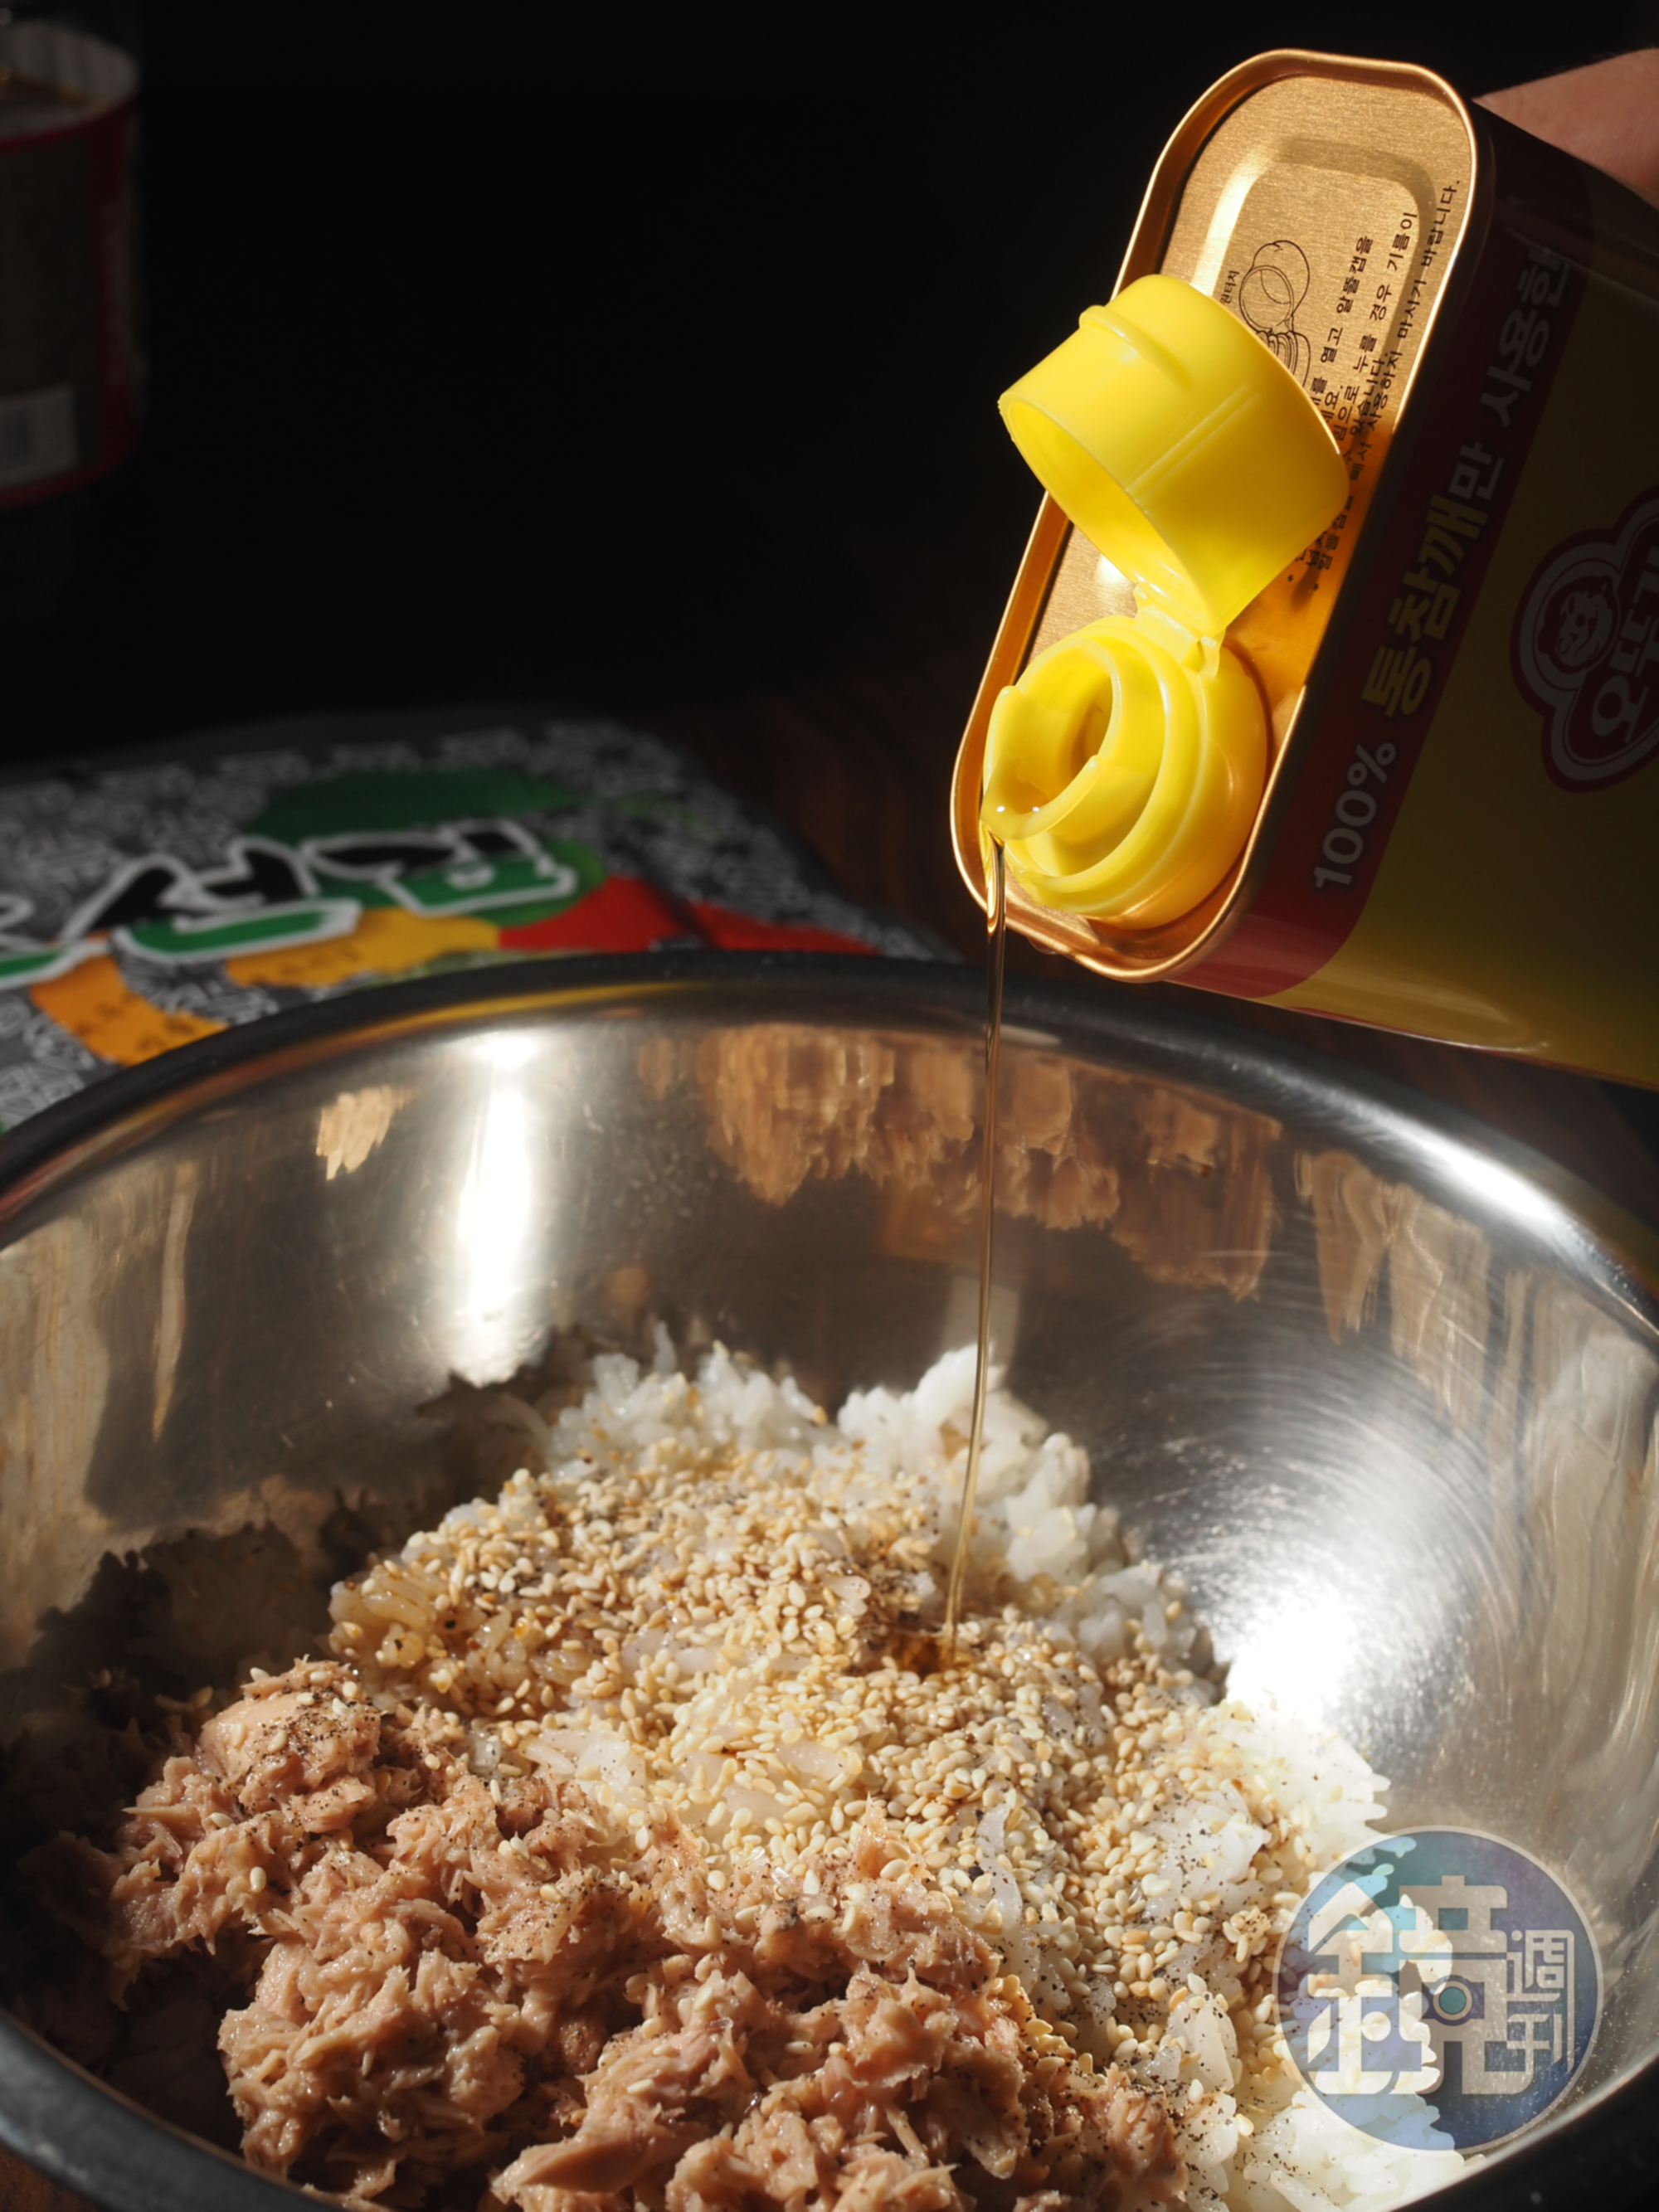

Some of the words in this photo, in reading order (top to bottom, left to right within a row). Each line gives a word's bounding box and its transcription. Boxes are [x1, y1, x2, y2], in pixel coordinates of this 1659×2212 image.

[1320, 328, 1344, 363] 열고
[1337, 236, 1374, 314] 알뜰캡을
[1353, 334, 1377, 372] 누를
[1370, 284, 1392, 322] 경우
[1387, 212, 1418, 271] 기름이
[1367, 352, 1404, 430] 사용하지
[1398, 280, 1427, 338] 마시기
[1421, 180, 1461, 267] 바랍니다.
[1351, 351, 1387, 434] 있습니다.
[1313, 742, 1396, 888] 100%
[1361, 441, 1506, 717] 통참깨만
[1480, 246, 1571, 428] 사용한
